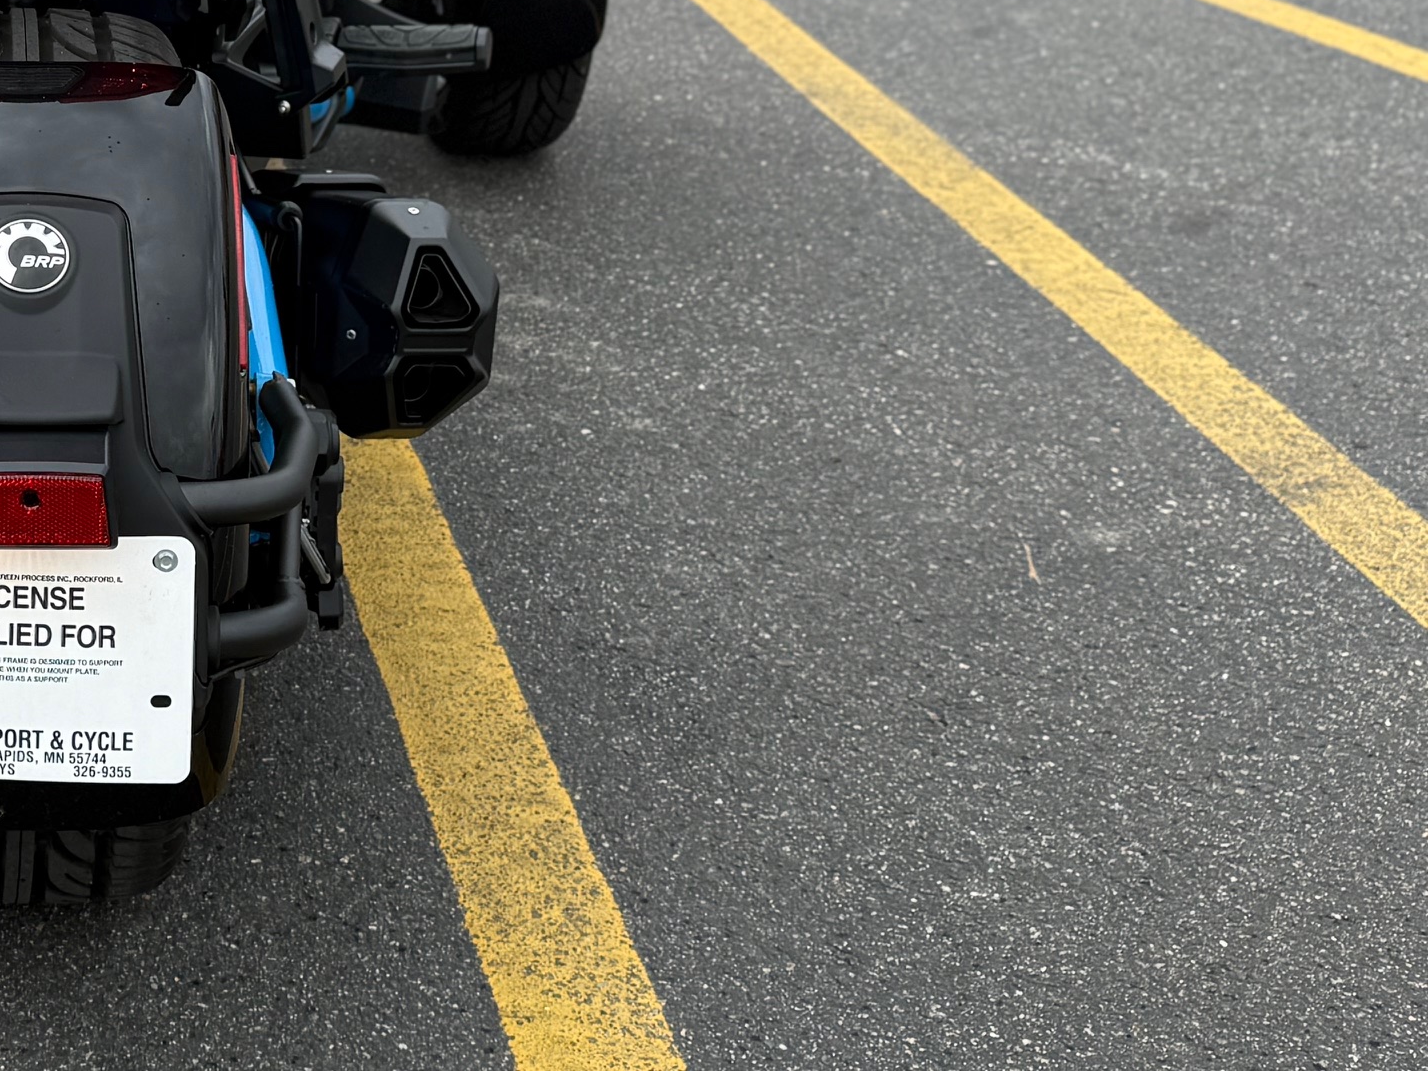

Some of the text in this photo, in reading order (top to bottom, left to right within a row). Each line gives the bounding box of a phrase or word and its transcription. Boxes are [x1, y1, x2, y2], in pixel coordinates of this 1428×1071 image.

[20, 255, 65, 268] BRP
[21, 574, 55, 582] PROCESS
[61, 624, 116, 648] FOR
[38, 658, 76, 666] DESIGNED
[50, 730, 63, 750] &
[71, 731, 133, 751] CYCLE
[44, 751, 64, 764] MN
[69, 752, 106, 764] 55744
[73, 765, 131, 778] 326-9355
